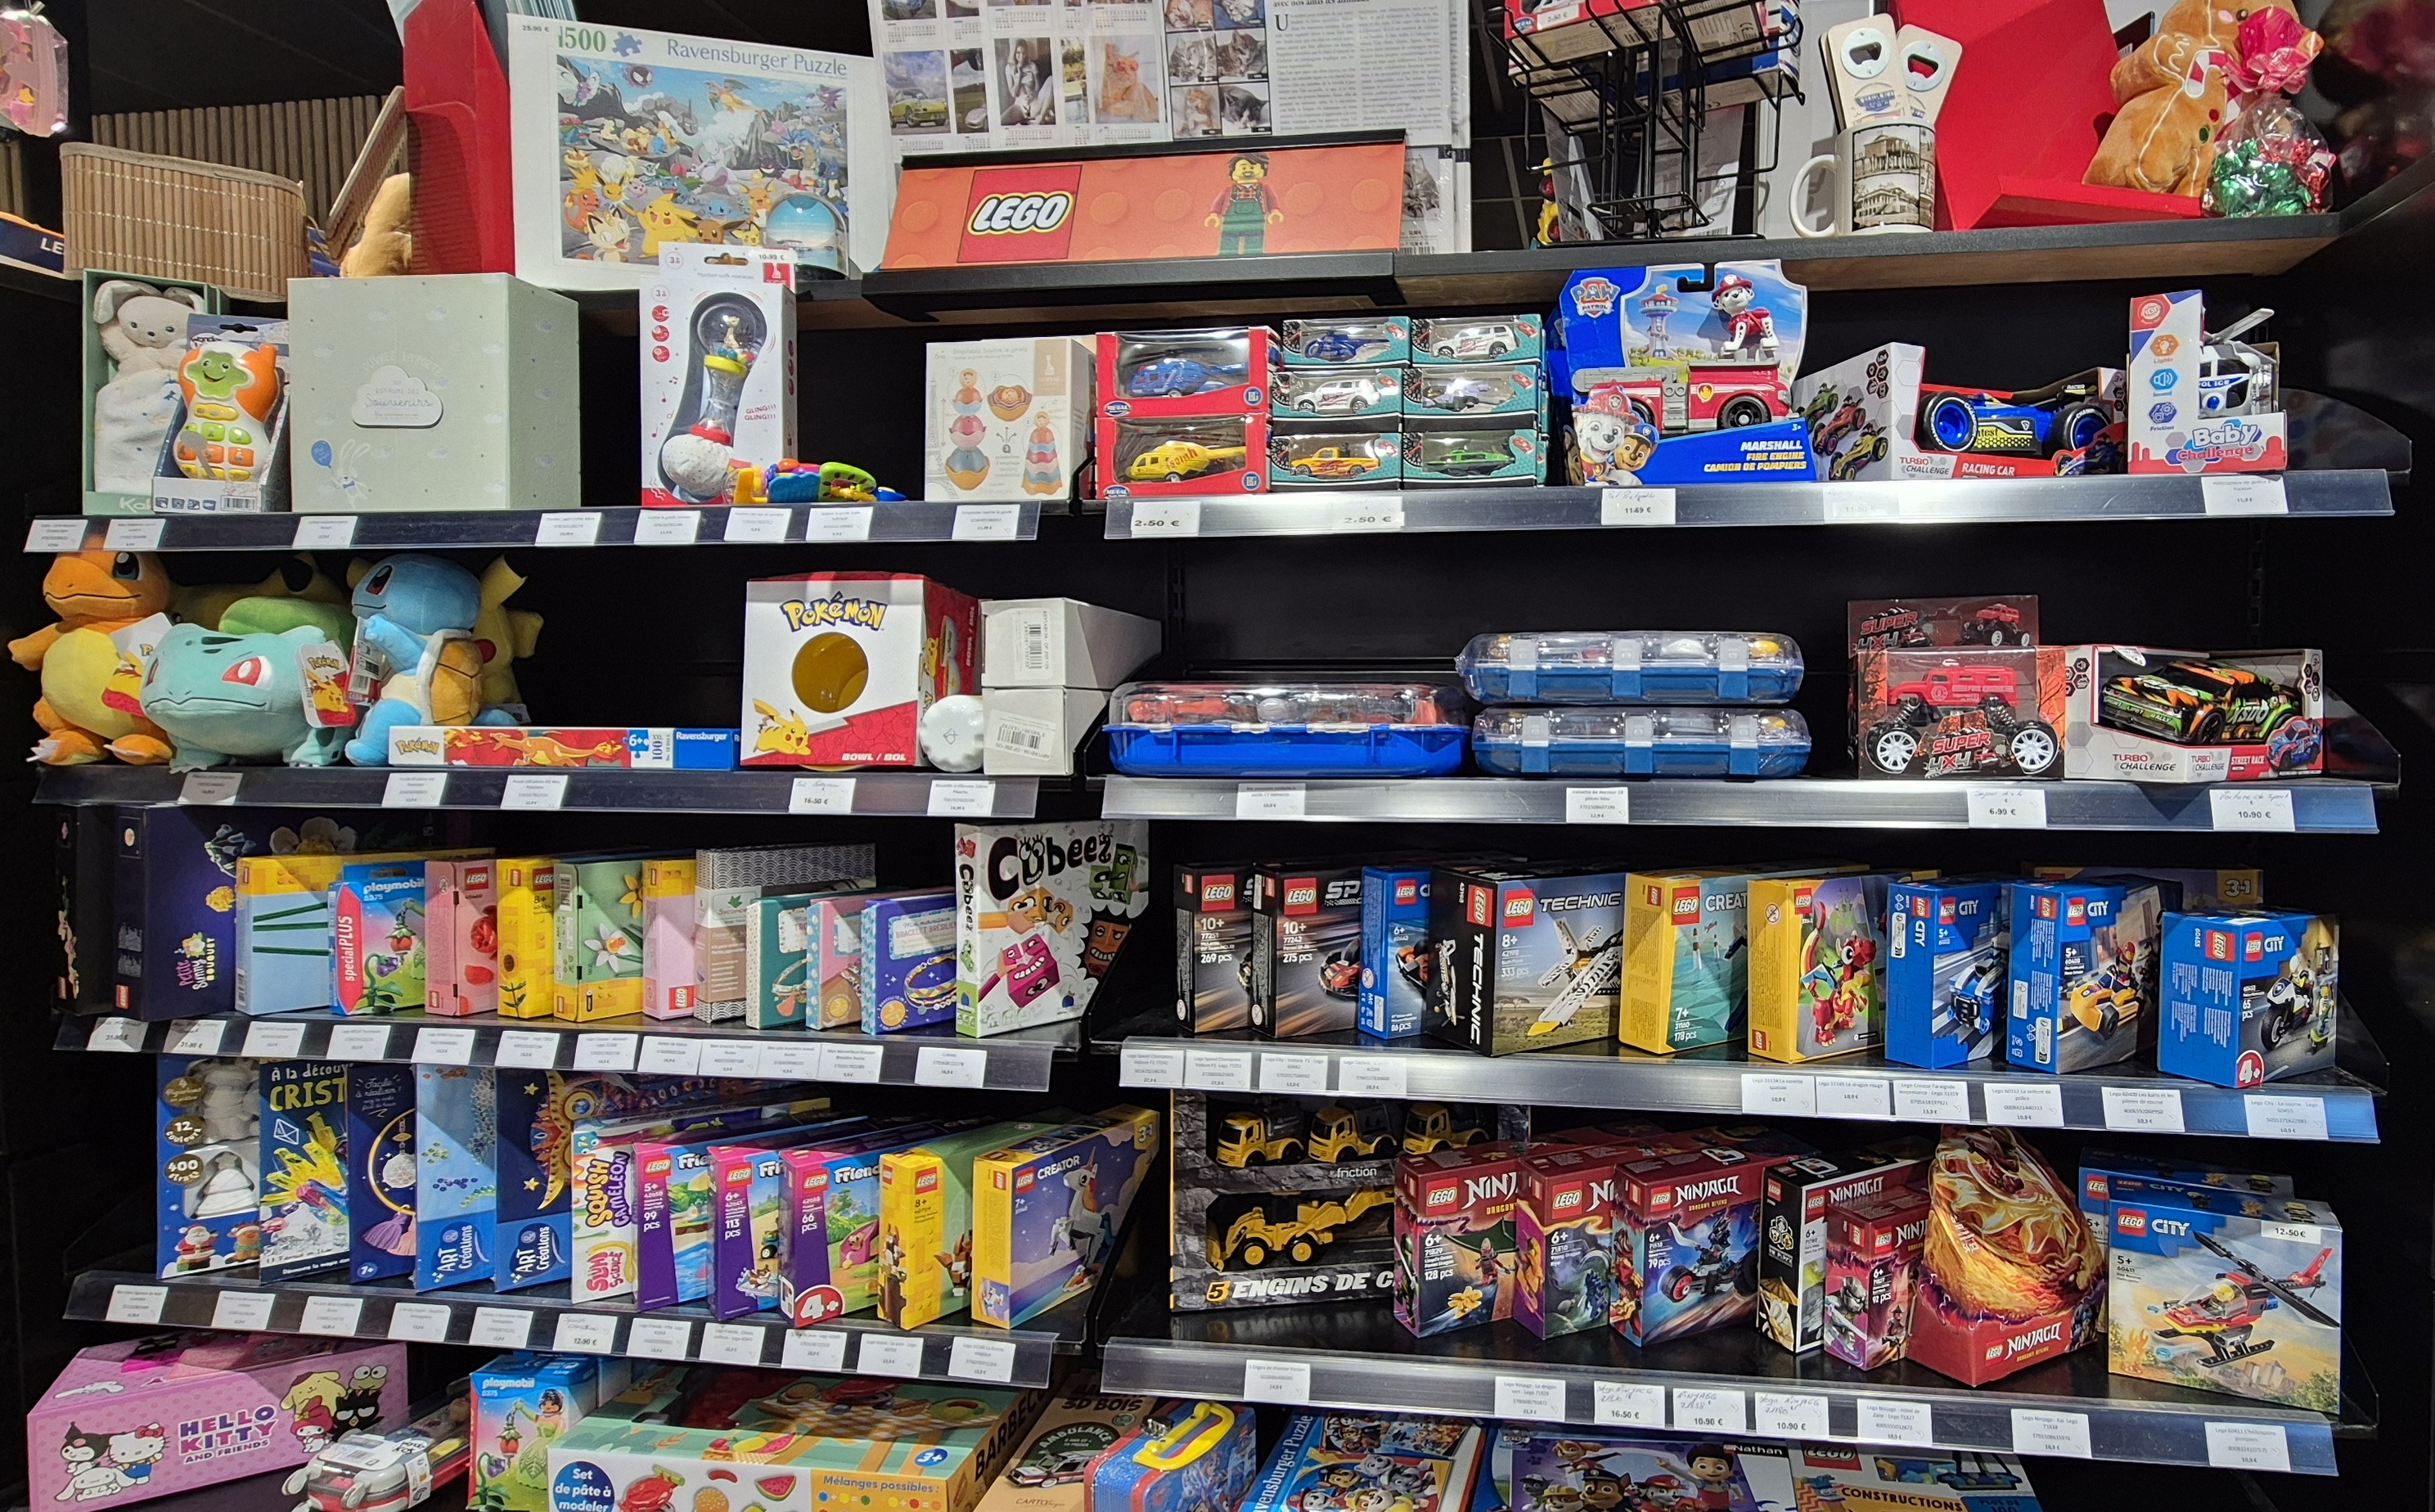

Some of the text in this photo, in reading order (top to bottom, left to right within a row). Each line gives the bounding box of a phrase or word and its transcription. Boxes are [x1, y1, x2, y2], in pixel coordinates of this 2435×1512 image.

[667, 38, 848, 77] Ravensburger Puzzle
[972, 196, 1069, 232] LEGO
[1574, 284, 1615, 299] PAW
[2193, 421, 2257, 449] Baby
[1741, 440, 1803, 452] MARSHALL
[2177, 444, 2254, 461] Challenge
[1899, 456, 1929, 465] TURBO
[1906, 462, 2015, 475] CHALLENGE RACING CAR
[1861, 611, 1919, 635] SUPER
[676, 731, 728, 744] Ravensburger
[1931, 731, 1992, 755] SUPER
[842, 753, 907, 762] BOWL BOL
[2113, 754, 2149, 763] TURBO
[2120, 761, 2176, 772] CHALLENGE
[2238, 810, 2272, 819] 10.90 €
[987, 833, 1113, 901] Cubeez
[466, 874, 486, 885] LEGO
[534, 874, 555, 884] LEGO
[363, 879, 425, 894] playmobil
[1204, 886, 1234, 899] LEGO
[1397, 886, 1415, 898] LEGO
[960, 863, 974, 933] Cubeez
[1286, 889, 1316, 902] LEGO
[1795, 895, 1811, 906] LEGO
[1472, 887, 1485, 921] LEGO
[1504, 893, 1623, 917] LEGO TECHNIC
[1672, 898, 1699, 914] LEGO
[1940, 899, 1979, 916] LEGO CITY
[2067, 901, 2109, 917] LEGO CITY
[1201, 918, 1225, 931] 10+
[1283, 921, 1307, 934] 10+
[1501, 934, 1518, 947] 8+
[1915, 920, 1926, 947] CITY
[2213, 931, 2226, 960] LEGO
[2246, 936, 2284, 953] LEGO CITY
[1201, 954, 1233, 965] 269 pcs
[1283, 953, 1312, 964] 275 pcs
[1501, 967, 1516, 978] 333
[1470, 933, 1483, 1045] TECHNIC
[1675, 1007, 1689, 1019] 7+
[286, 1065, 299, 1079] la
[2239, 1059, 2261, 1084] 4+
[174, 1121, 193, 1132] 12
[168, 1159, 199, 1172] 400
[646, 1161, 671, 1173] LEGO
[1016, 1154, 1080, 1189] LEGO CREATOR
[1337, 1166, 1376, 1179] friction
[727, 1168, 751, 1181] LEGO
[805, 1175, 828, 1188] LEGO
[916, 1172, 937, 1188] LEGO
[587, 1158, 613, 1227] SQUISH
[610, 1152, 632, 1227] CAMELEON
[725, 1192, 740, 1201] 6+
[1653, 1176, 1742, 1208] LEGO NINJAGO
[1807, 1176, 1885, 1209] LEGO NINJAGO
[1427, 1187, 1457, 1207] LEGO
[1552, 1190, 1582, 1208] LEGO
[645, 1211, 658, 1221] 99
[803, 1213, 816, 1222] 66
[644, 1222, 661, 1232] pcs
[802, 1222, 818, 1233] pcs
[2118, 1215, 2191, 1236] LEGO CITY
[725, 1229, 741, 1240] pcs
[1551, 1231, 1568, 1243] 6+
[1875, 1232, 1892, 1245] LEGO
[2275, 1228, 2307, 1238] 12.50 €
[458, 1225, 473, 1270] Créations
[1425, 1234, 1443, 1247] 6+
[537, 1226, 551, 1271] Créations
[437, 1248, 459, 1271] ART
[515, 1249, 537, 1272] ART
[2117, 1255, 2132, 1265] 5+
[1206, 1281, 1229, 1302] 5
[1233, 1275, 1329, 1300] ENGINS
[1335, 1273, 1369, 1293] DE
[800, 1293, 839, 1320] 4+
[1986, 1322, 2063, 1361] LEGO NINJAGO
[483, 1377, 535, 1390] playmobil
[1062, 1397, 1143, 1411] 3D BOIS
[179, 1405, 276, 1438] HELLO
[1612, 1411, 1632, 1419] 16.50
[1695, 1418, 1715, 1426] 10.90
[1285, 1414, 1314, 1451] Puzzle
[1777, 1421, 1798, 1430] 10.90
[180, 1421, 277, 1454] KITTY
[1037, 1424, 1111, 1449] AMBULANCE
[185, 1440, 269, 1464] AND FRIENDS
[1734, 1443, 1783, 1457] Nathan
[1805, 1446, 1854, 1462] LEGO
[916, 1451, 943, 1464] 3+
[573, 1469, 592, 1481] Set
[555, 1483, 611, 1499] de pâte à
[823, 1475, 934, 1494] Mélanges possibles
[1841, 1487, 1963, 1511] CONSTRUCTIONS
[558, 1501, 609, 1512] modeler
